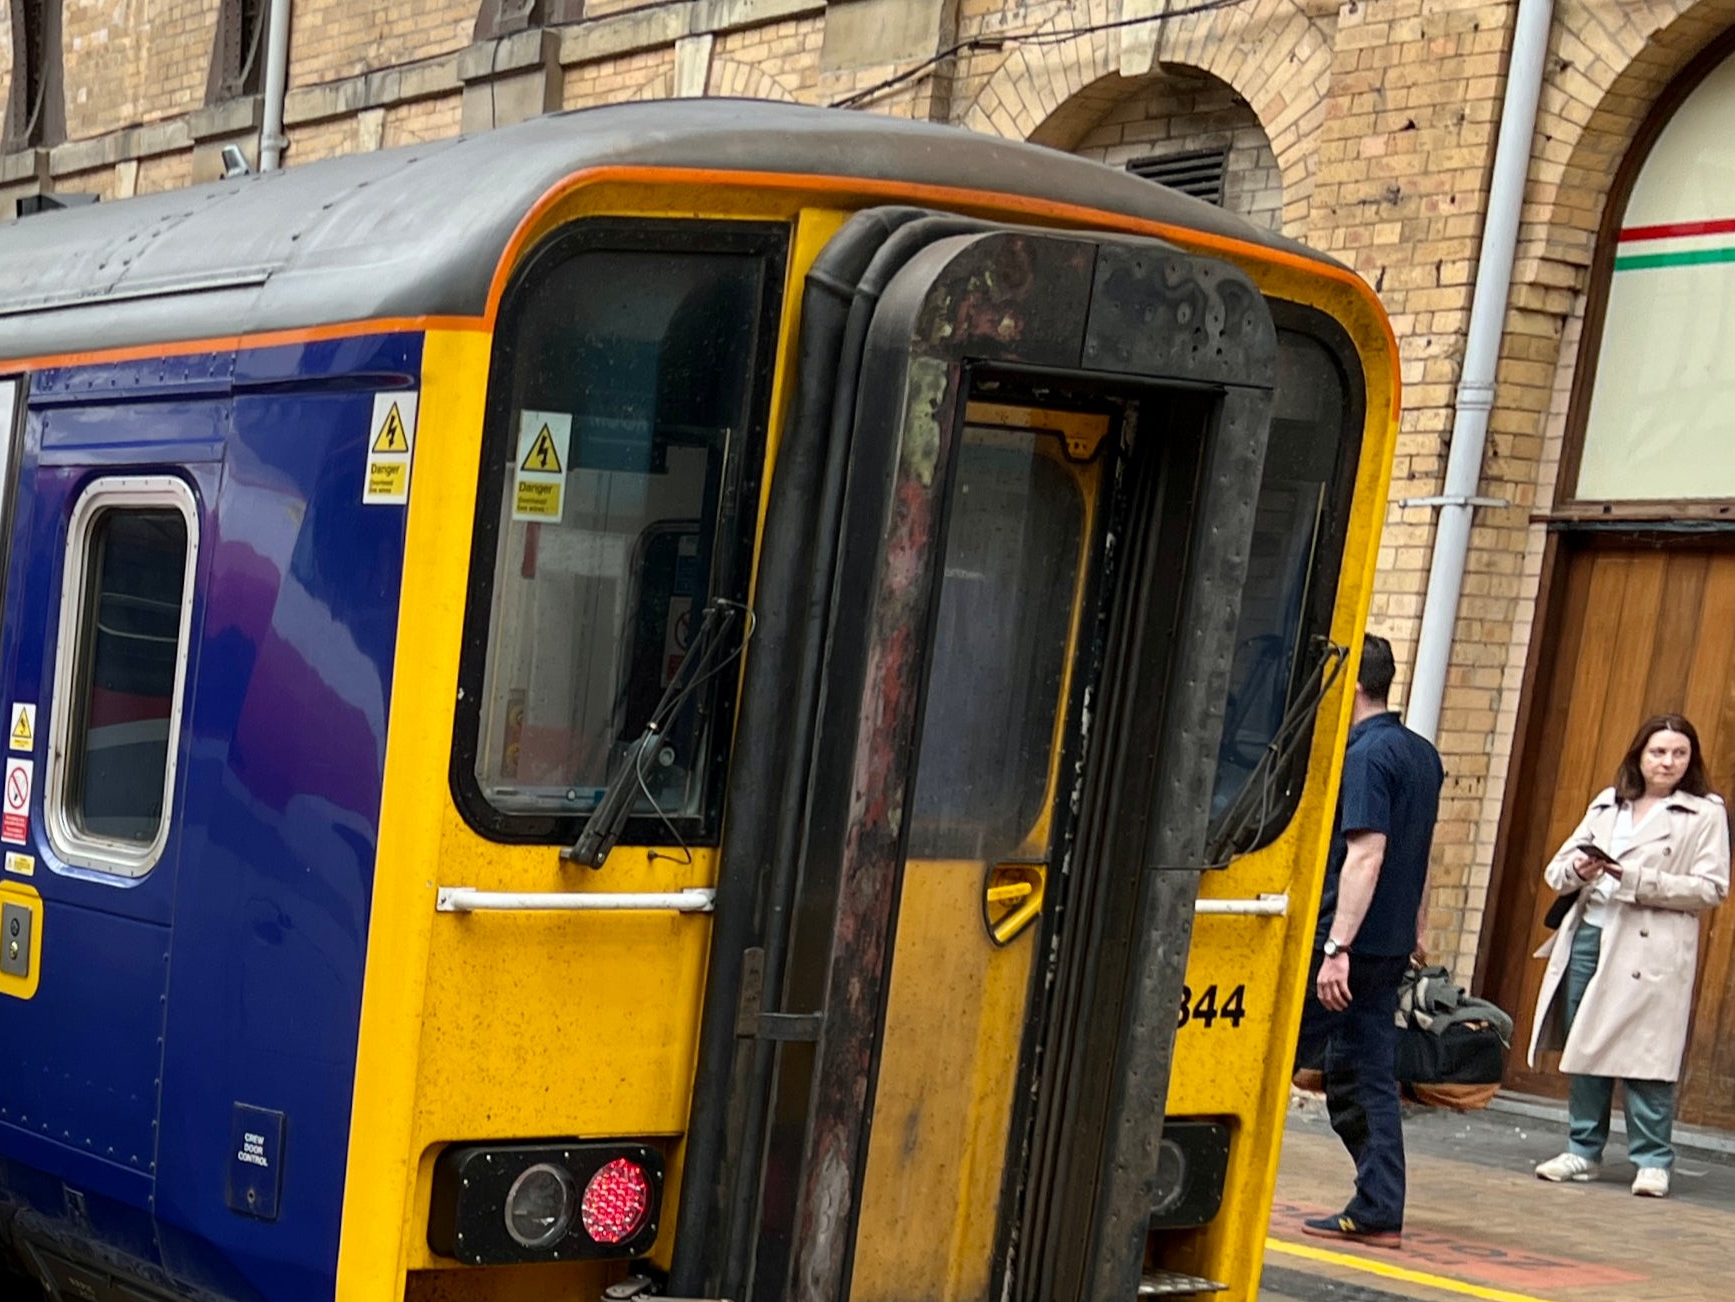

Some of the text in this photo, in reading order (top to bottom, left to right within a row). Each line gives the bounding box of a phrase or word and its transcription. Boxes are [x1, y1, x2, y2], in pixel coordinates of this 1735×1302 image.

[370, 463, 400, 477] Danger
[518, 481, 553, 495] Danger
[244, 1132, 264, 1145] CREW
[243, 1142, 264, 1155] DOOR
[237, 1151, 268, 1167] CONTROL
